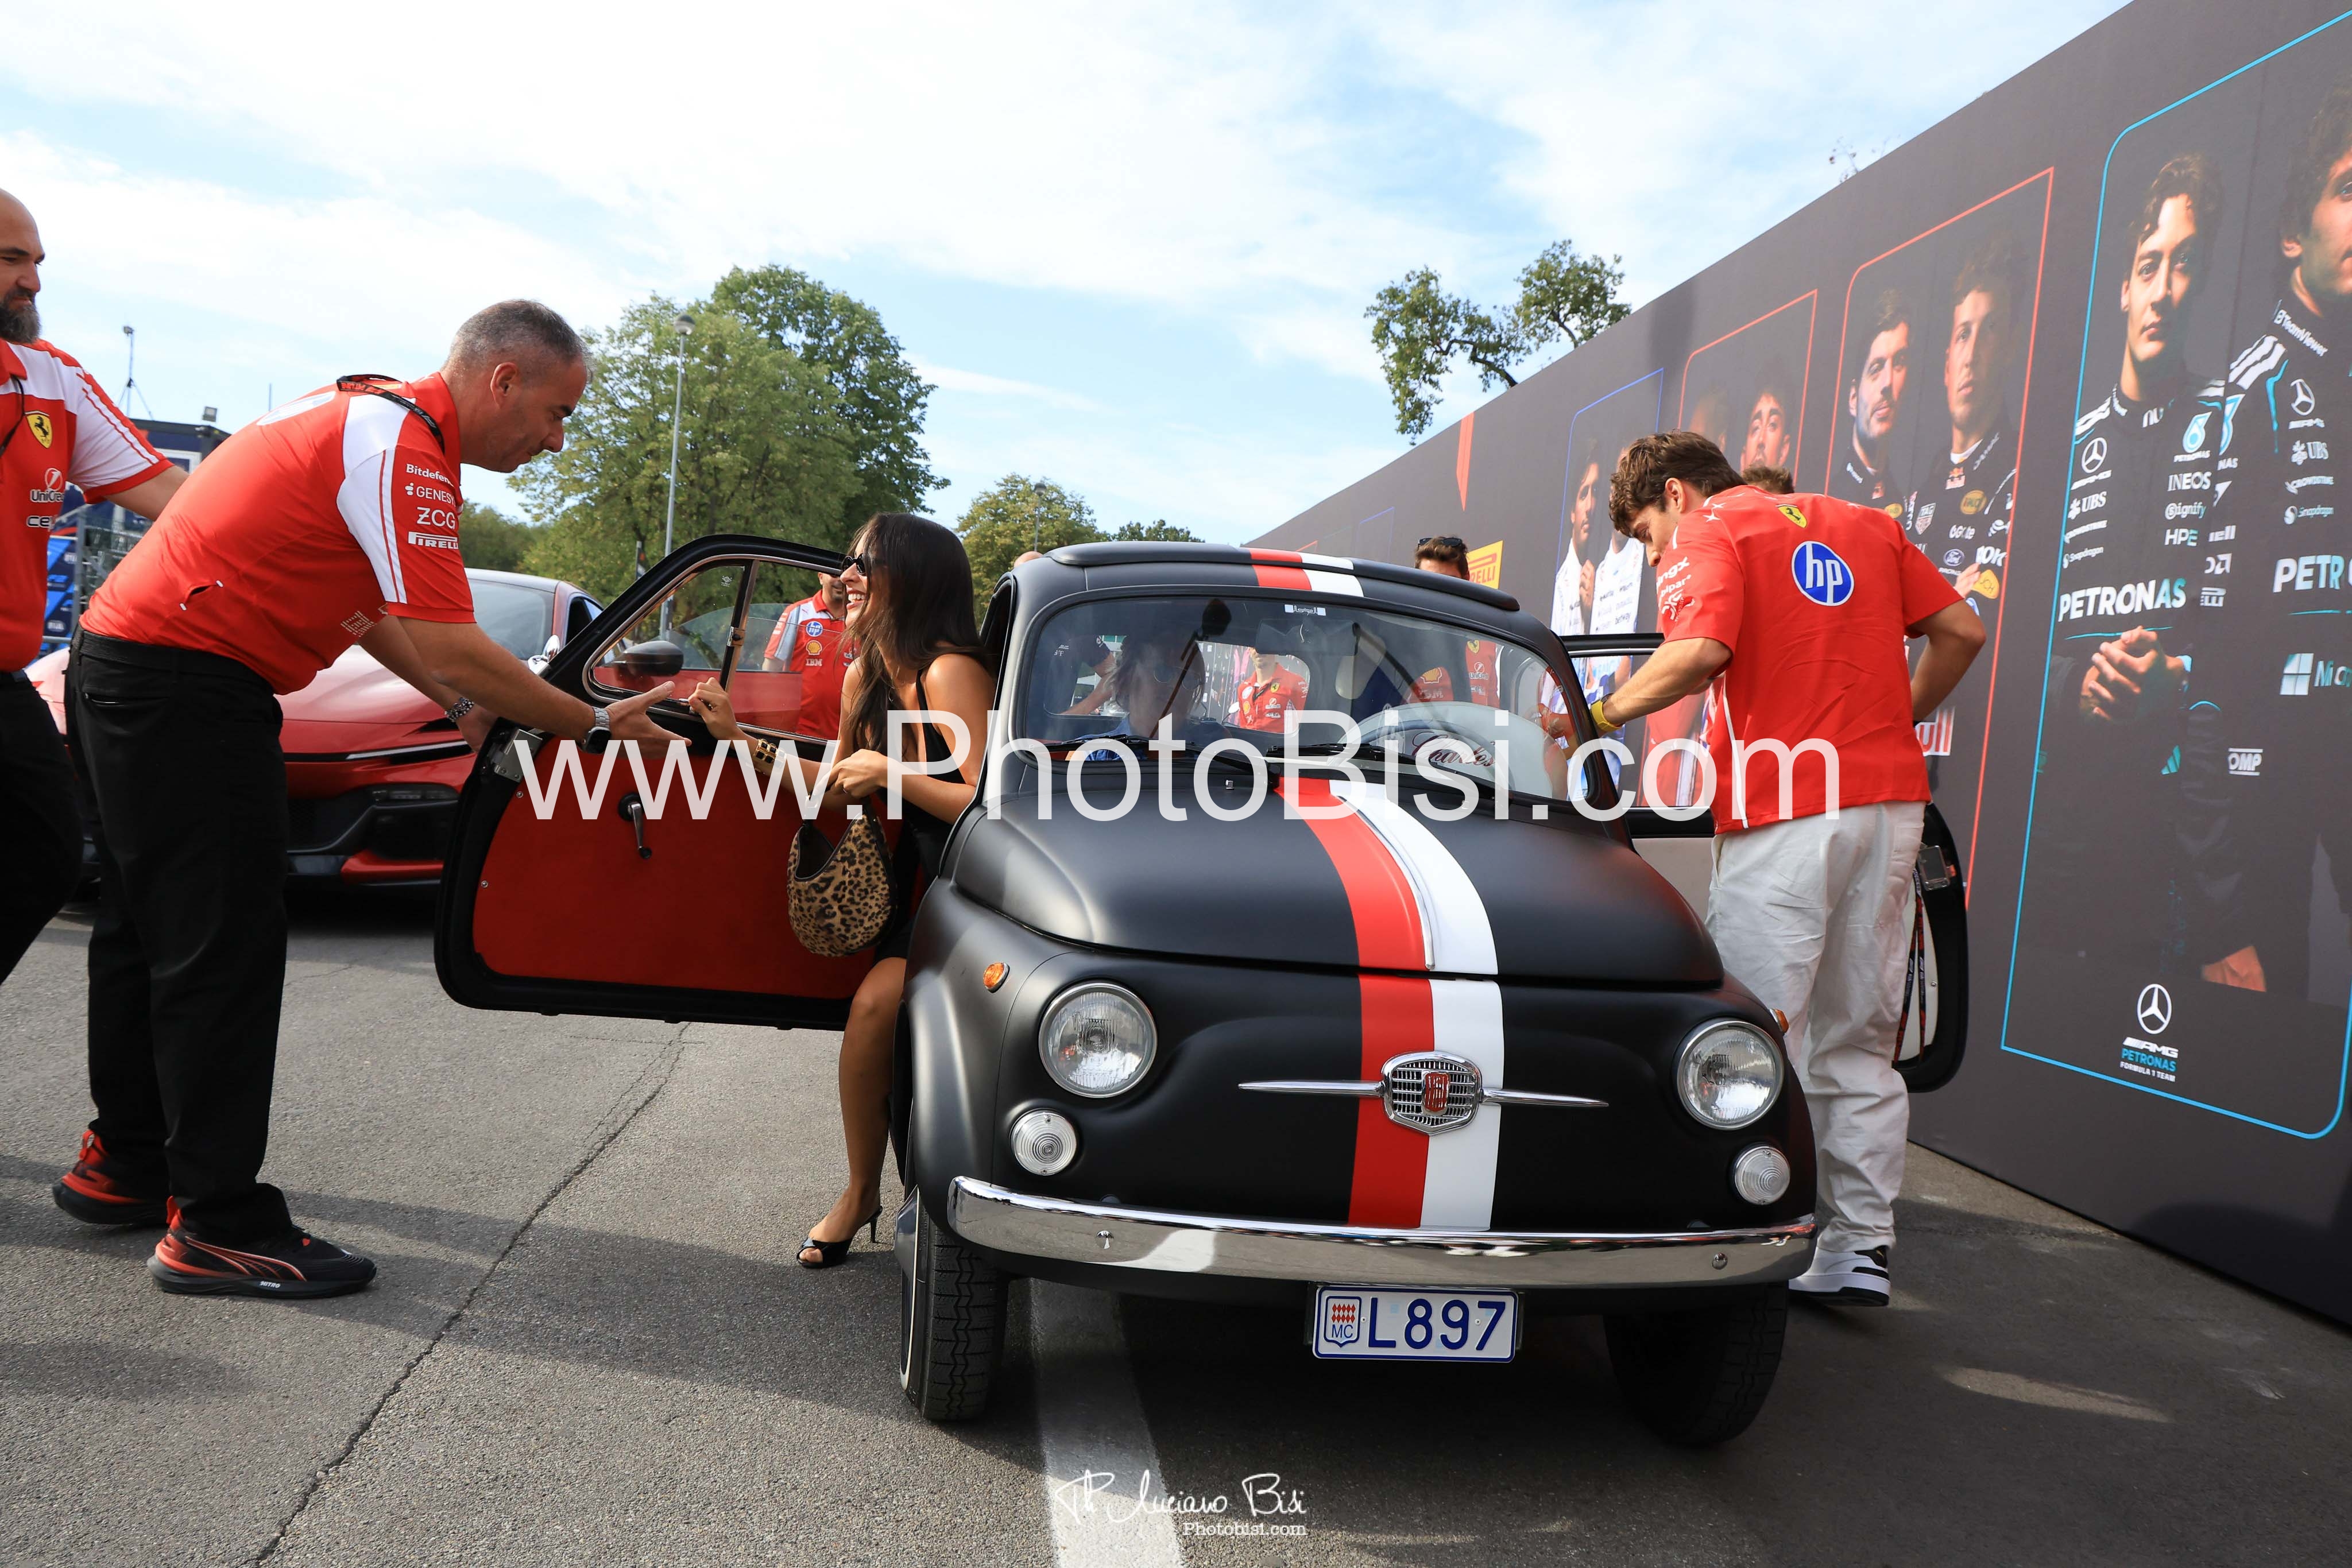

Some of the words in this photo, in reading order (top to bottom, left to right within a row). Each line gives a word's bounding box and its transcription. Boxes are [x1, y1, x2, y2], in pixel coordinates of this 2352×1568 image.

[2307, 441, 2329, 460] UBS
[2167, 471, 2212, 491] INEOS
[2081, 491, 2107, 513] UBS
[2164, 528, 2199, 547] HPE
[1803, 541, 1844, 606] hp
[2058, 578, 2187, 622] PETRONAS
[2228, 752, 2262, 771] OMP
[2121, 1048, 2177, 1072] PETRONAS
[1331, 1324, 1353, 1339] MC
[1368, 1296, 1506, 1351] L897
